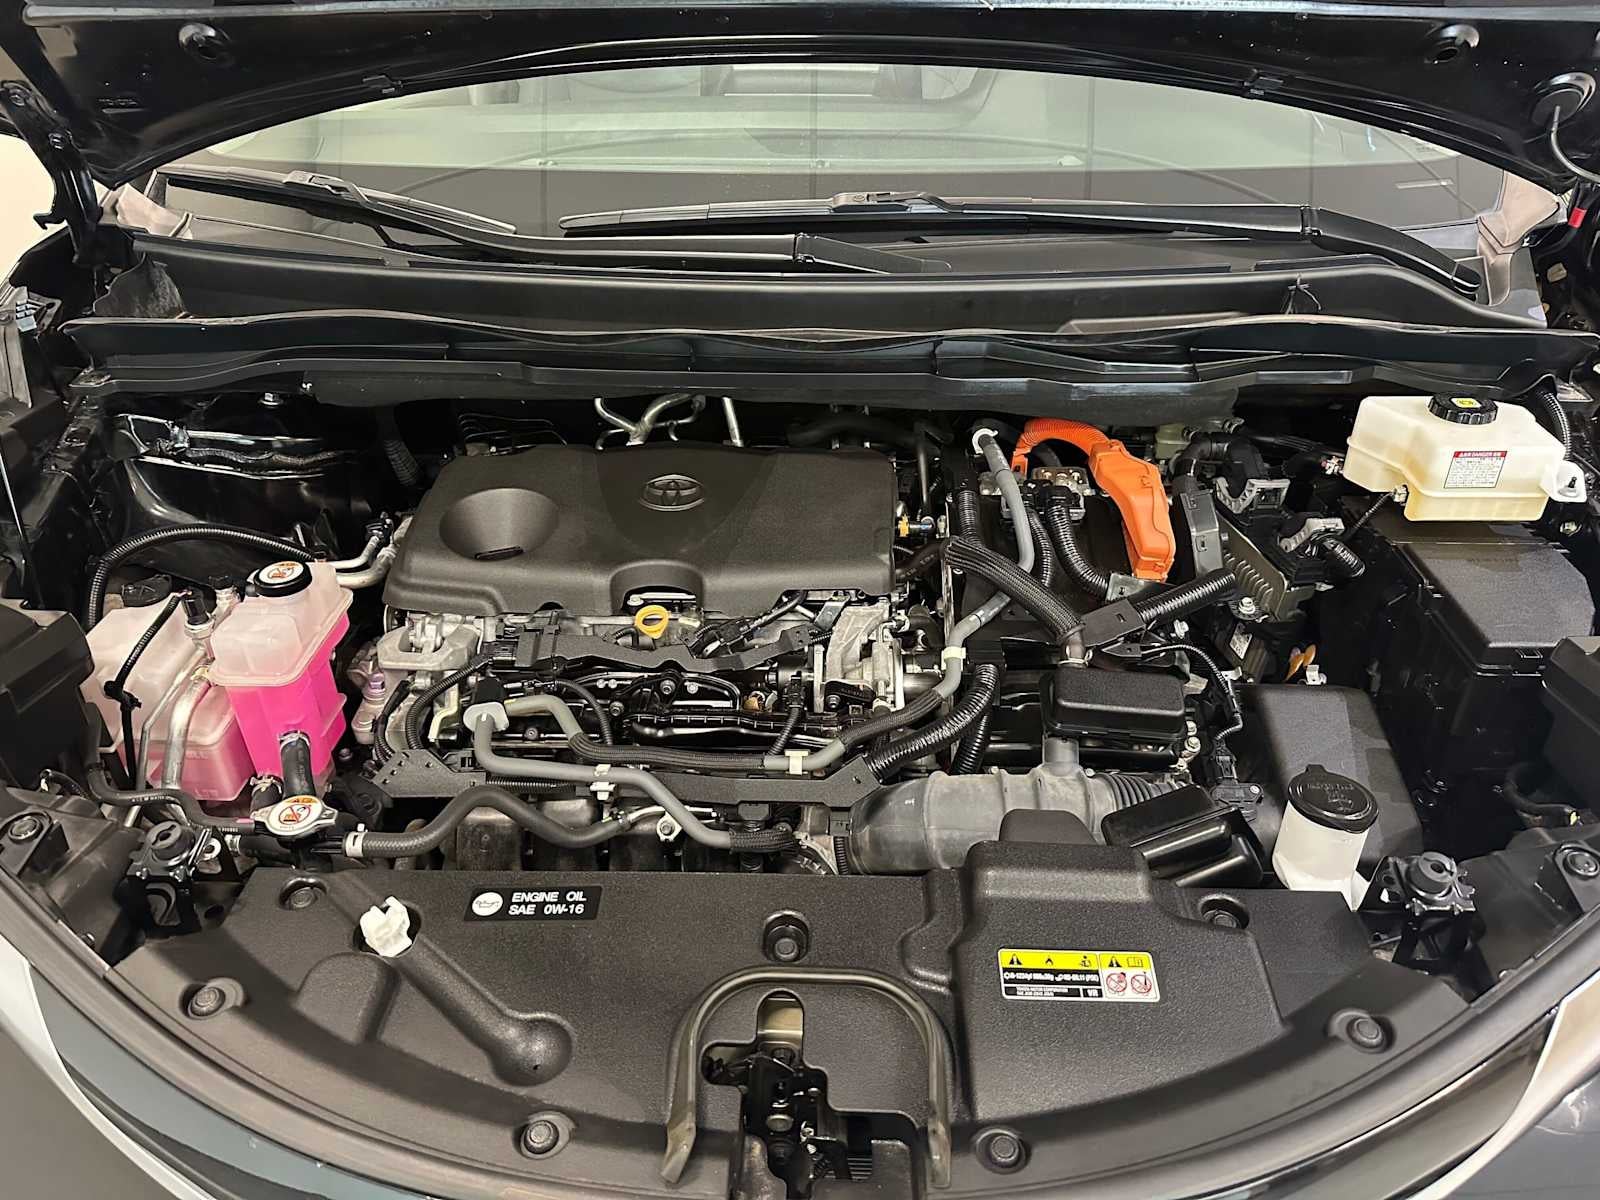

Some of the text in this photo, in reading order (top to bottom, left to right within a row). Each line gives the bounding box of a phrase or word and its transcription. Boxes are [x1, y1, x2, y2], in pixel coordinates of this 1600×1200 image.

[511, 890, 587, 903] ENGINE OIL
[508, 904, 585, 915] SAE 0W-16
